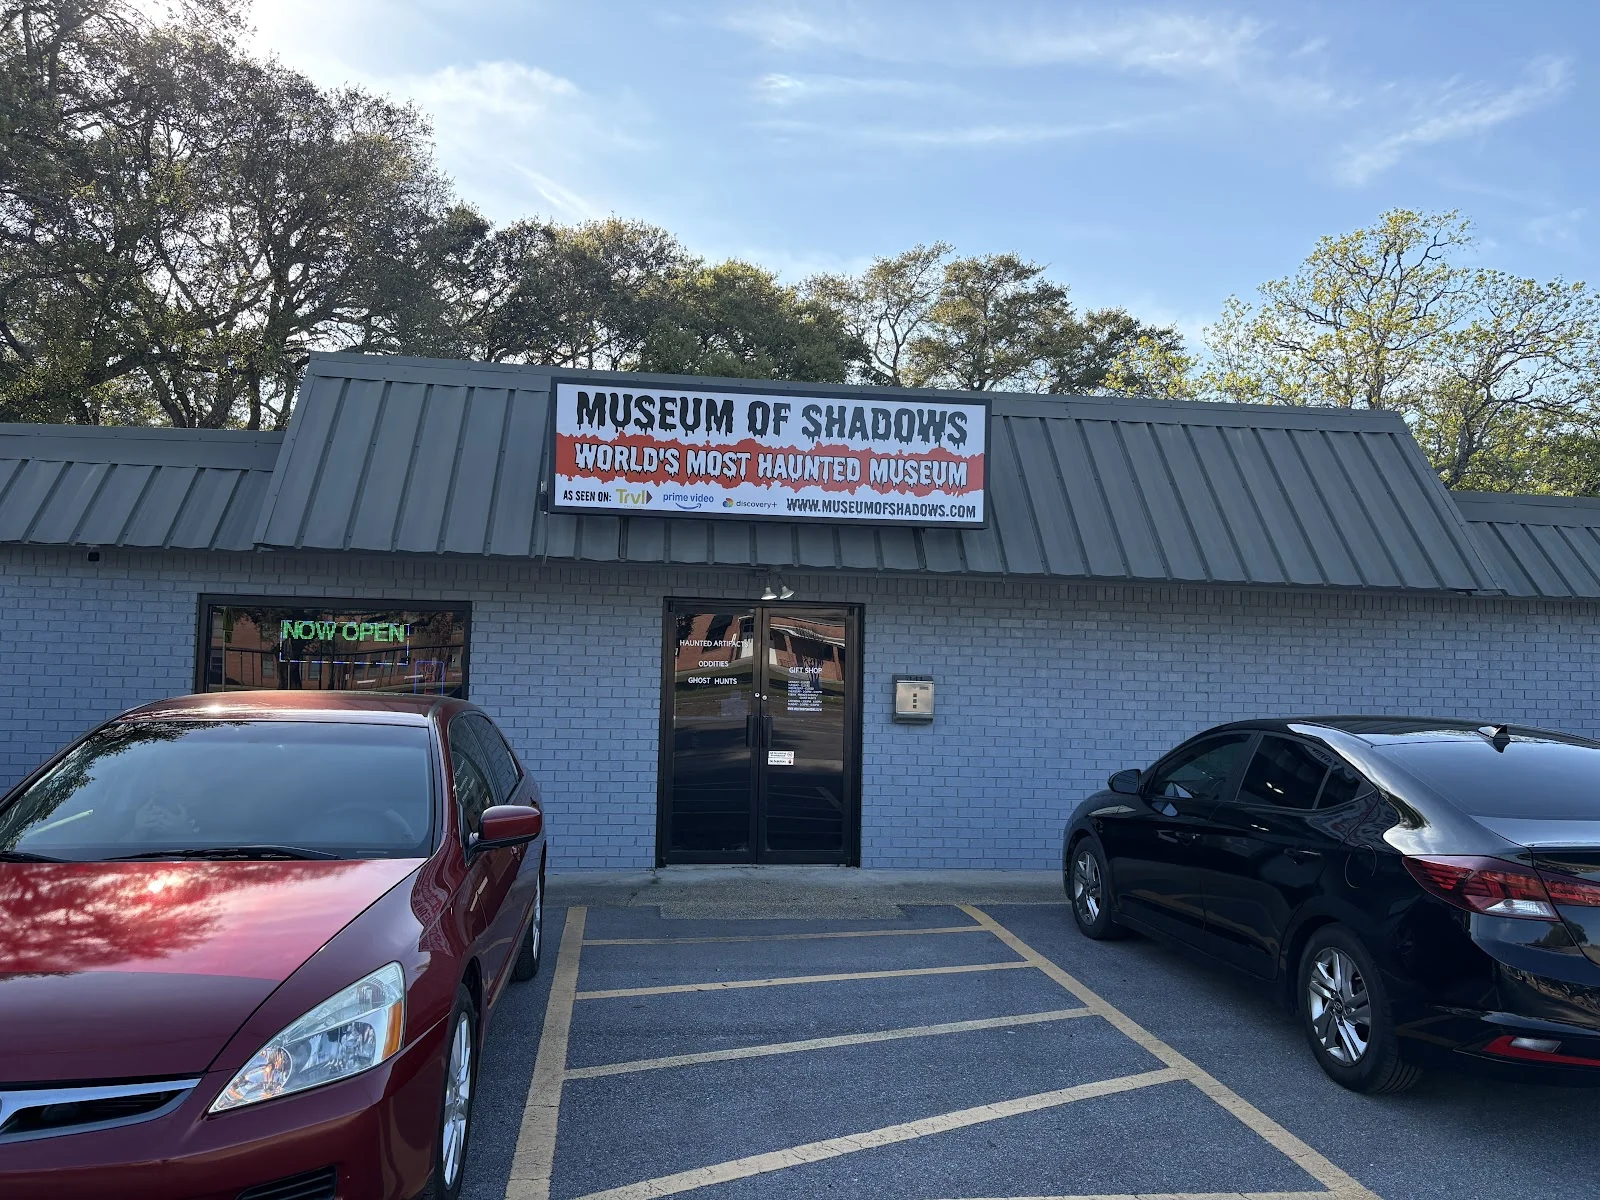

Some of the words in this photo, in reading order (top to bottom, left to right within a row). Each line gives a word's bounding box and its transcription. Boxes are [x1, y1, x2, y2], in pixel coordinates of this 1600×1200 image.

[577, 391, 734, 437] MUSEUM
[748, 401, 791, 438] OF
[802, 404, 968, 449] SHADOWS
[574, 442, 680, 477] WORLD'S
[686, 449, 751, 482] MOST
[757, 452, 861, 485] HAUNTED
[869, 457, 968, 490] MUSEUM
[563, 490, 574, 501] AS
[575, 490, 596, 502] SEEN
[597, 491, 612, 503] ON:
[663, 493, 688, 504] prime
[690, 493, 714, 503] video
[787, 498, 976, 519] WWW.MUSEUMOFSHADOWS.COM
[282, 621, 335, 641] NOW
[342, 622, 405, 643] OPEN
[679, 639, 713, 647] HAUNTED
[713, 640, 749, 648] ARTIFACTS
[788, 666, 803, 674] GIFT
[687, 676, 711, 684] GHOST
[714, 677, 738, 685] HUNTS
